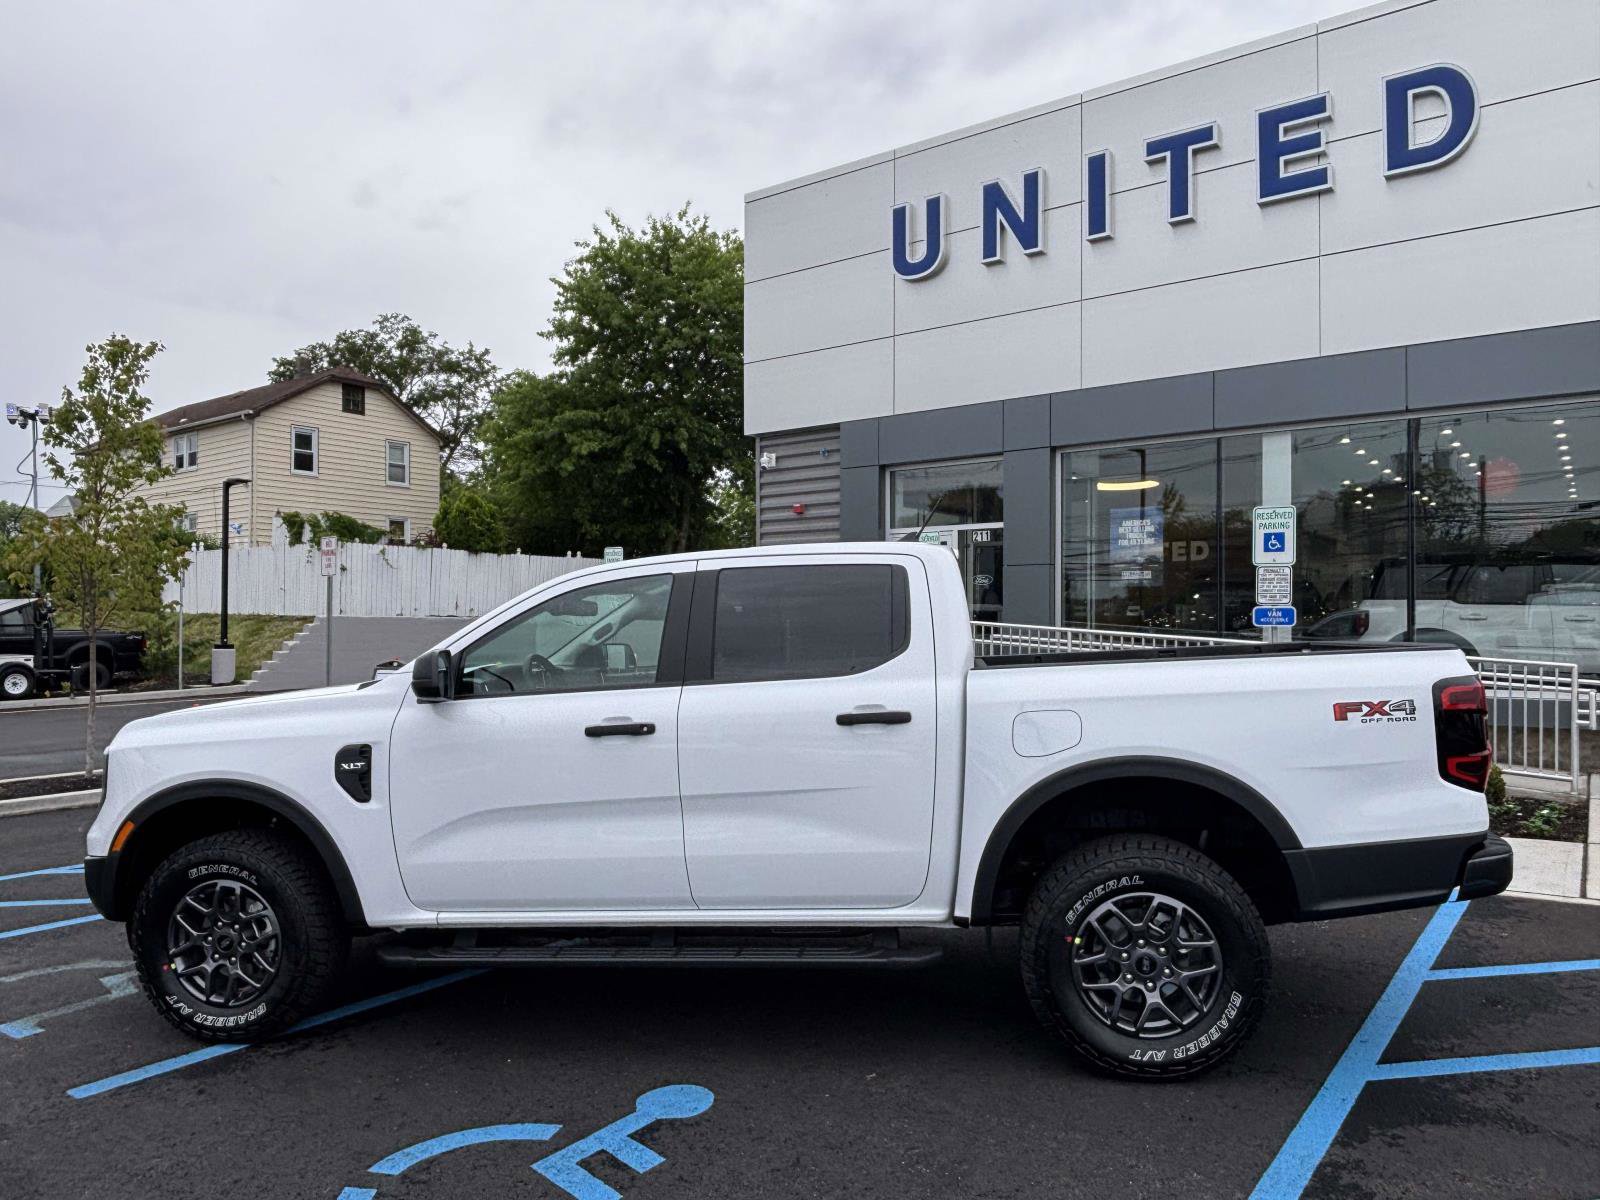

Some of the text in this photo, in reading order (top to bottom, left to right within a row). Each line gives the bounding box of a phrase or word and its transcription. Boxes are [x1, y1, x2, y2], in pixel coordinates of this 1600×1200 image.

[892, 62, 1480, 281] UNITED
[1257, 511, 1293, 520] RESERVED
[1258, 522, 1291, 530] PARKING
[973, 531, 991, 542] 211
[1333, 699, 1417, 722] FX4
[188, 864, 259, 886] GENERAL
[1065, 875, 1145, 925] GENERAL
[165, 994, 267, 1027] GRABBER A/T
[1129, 991, 1242, 1062] GRABBER A/T
